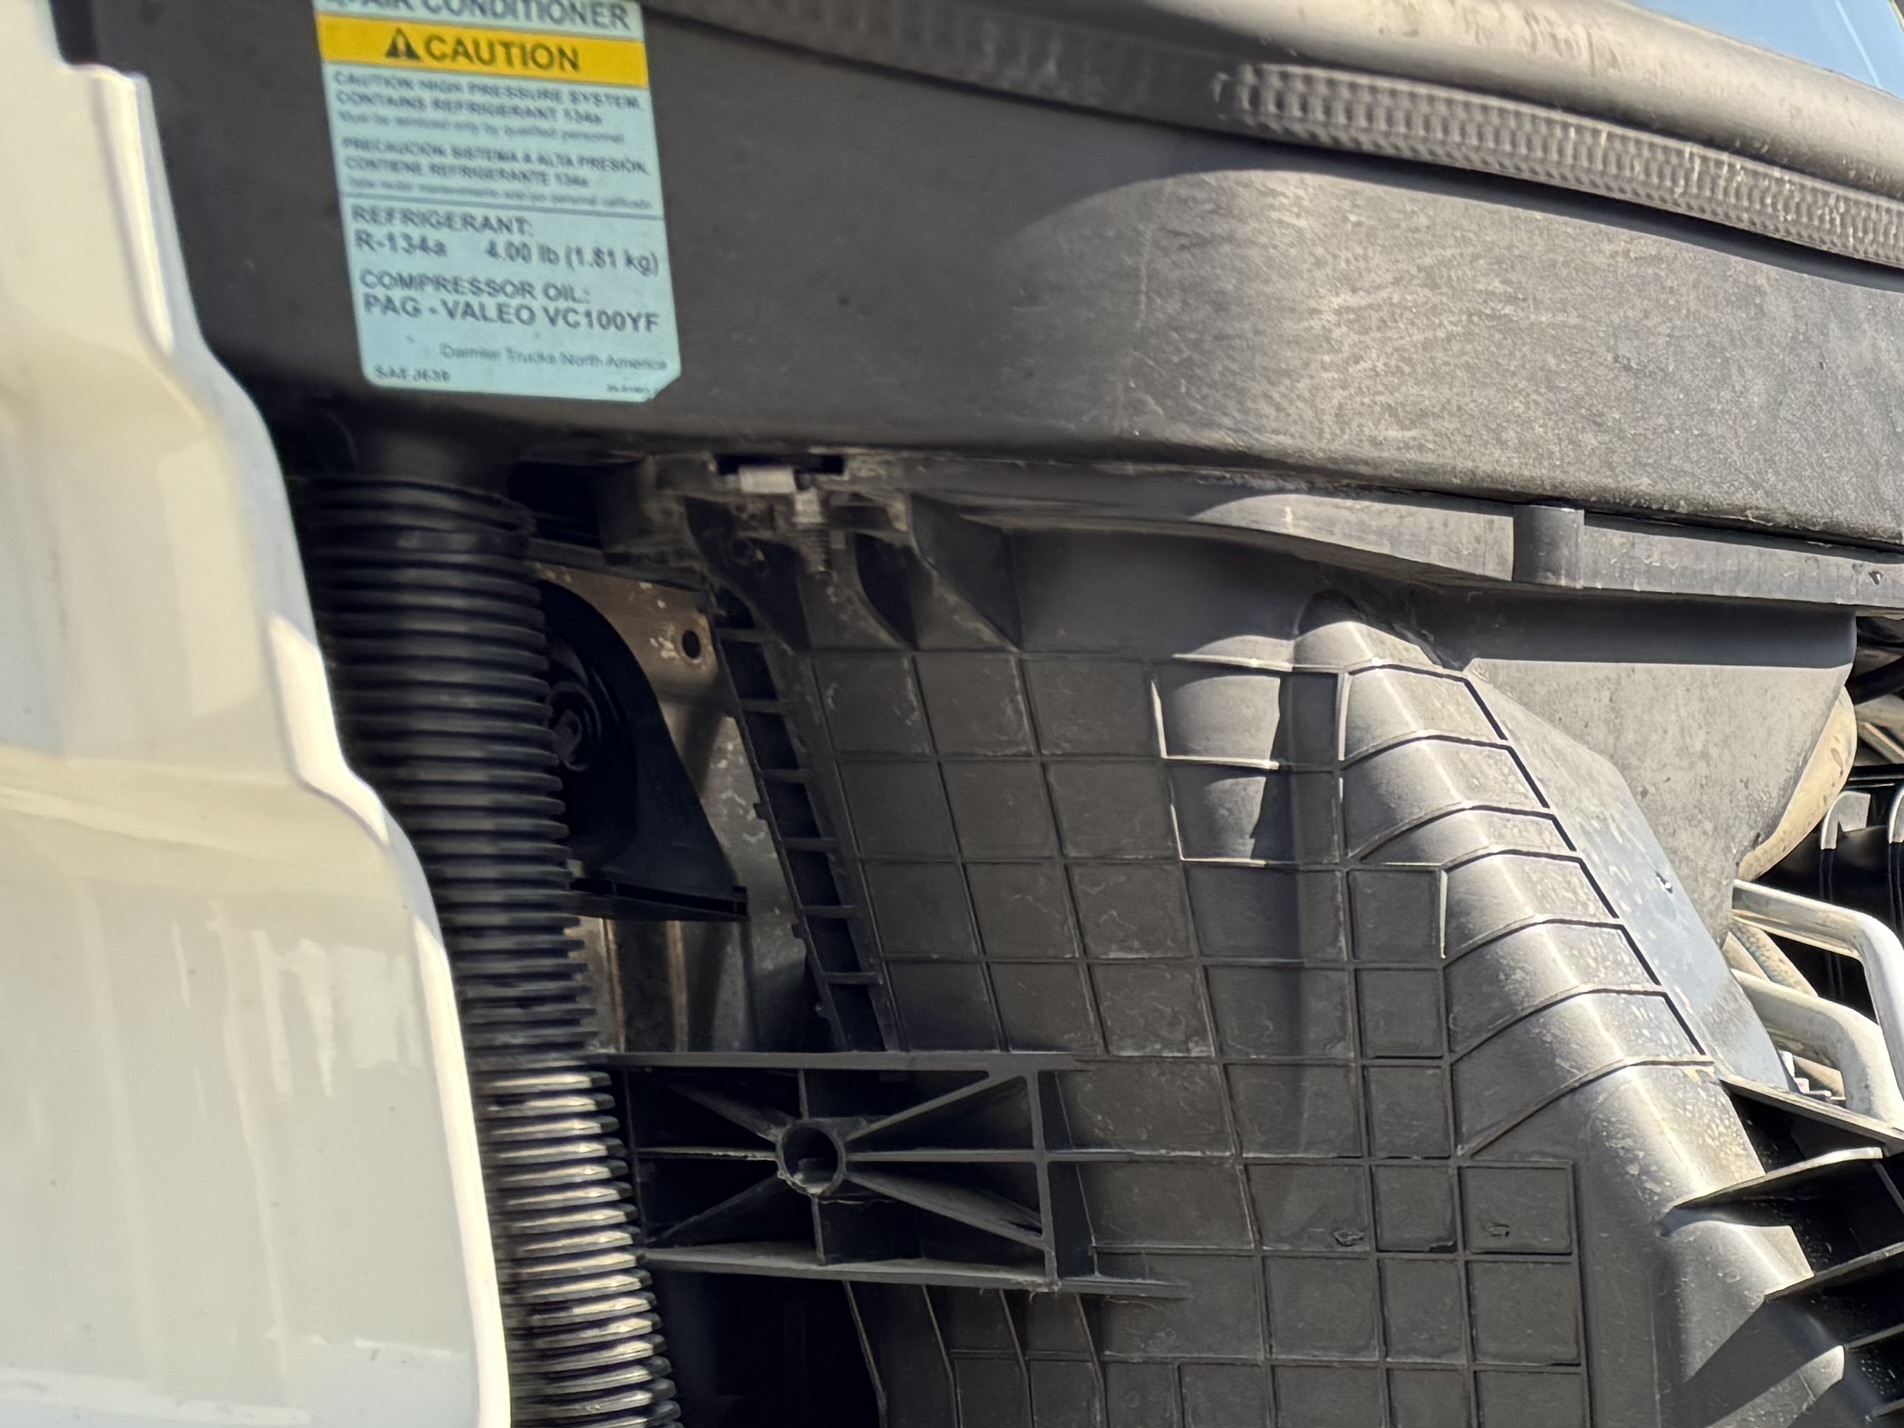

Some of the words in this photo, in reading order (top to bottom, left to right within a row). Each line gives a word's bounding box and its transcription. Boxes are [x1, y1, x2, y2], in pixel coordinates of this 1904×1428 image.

[426, 0, 630, 31] CONDITIONER
[424, 34, 581, 72] CAUTION
[466, 82, 563, 104] PRESSURE
[433, 99, 557, 121] REFRIGERANT
[351, 204, 534, 237] REFRIGERANT:
[354, 228, 448, 258] R-134a
[484, 238, 532, 264] 4.00
[537, 241, 560, 266] lb
[624, 247, 660, 277] kg)
[359, 268, 537, 301] COMPRESSOR
[362, 292, 422, 319] PAG
[439, 297, 537, 327] VALEO
[541, 306, 660, 334] VC100YF
